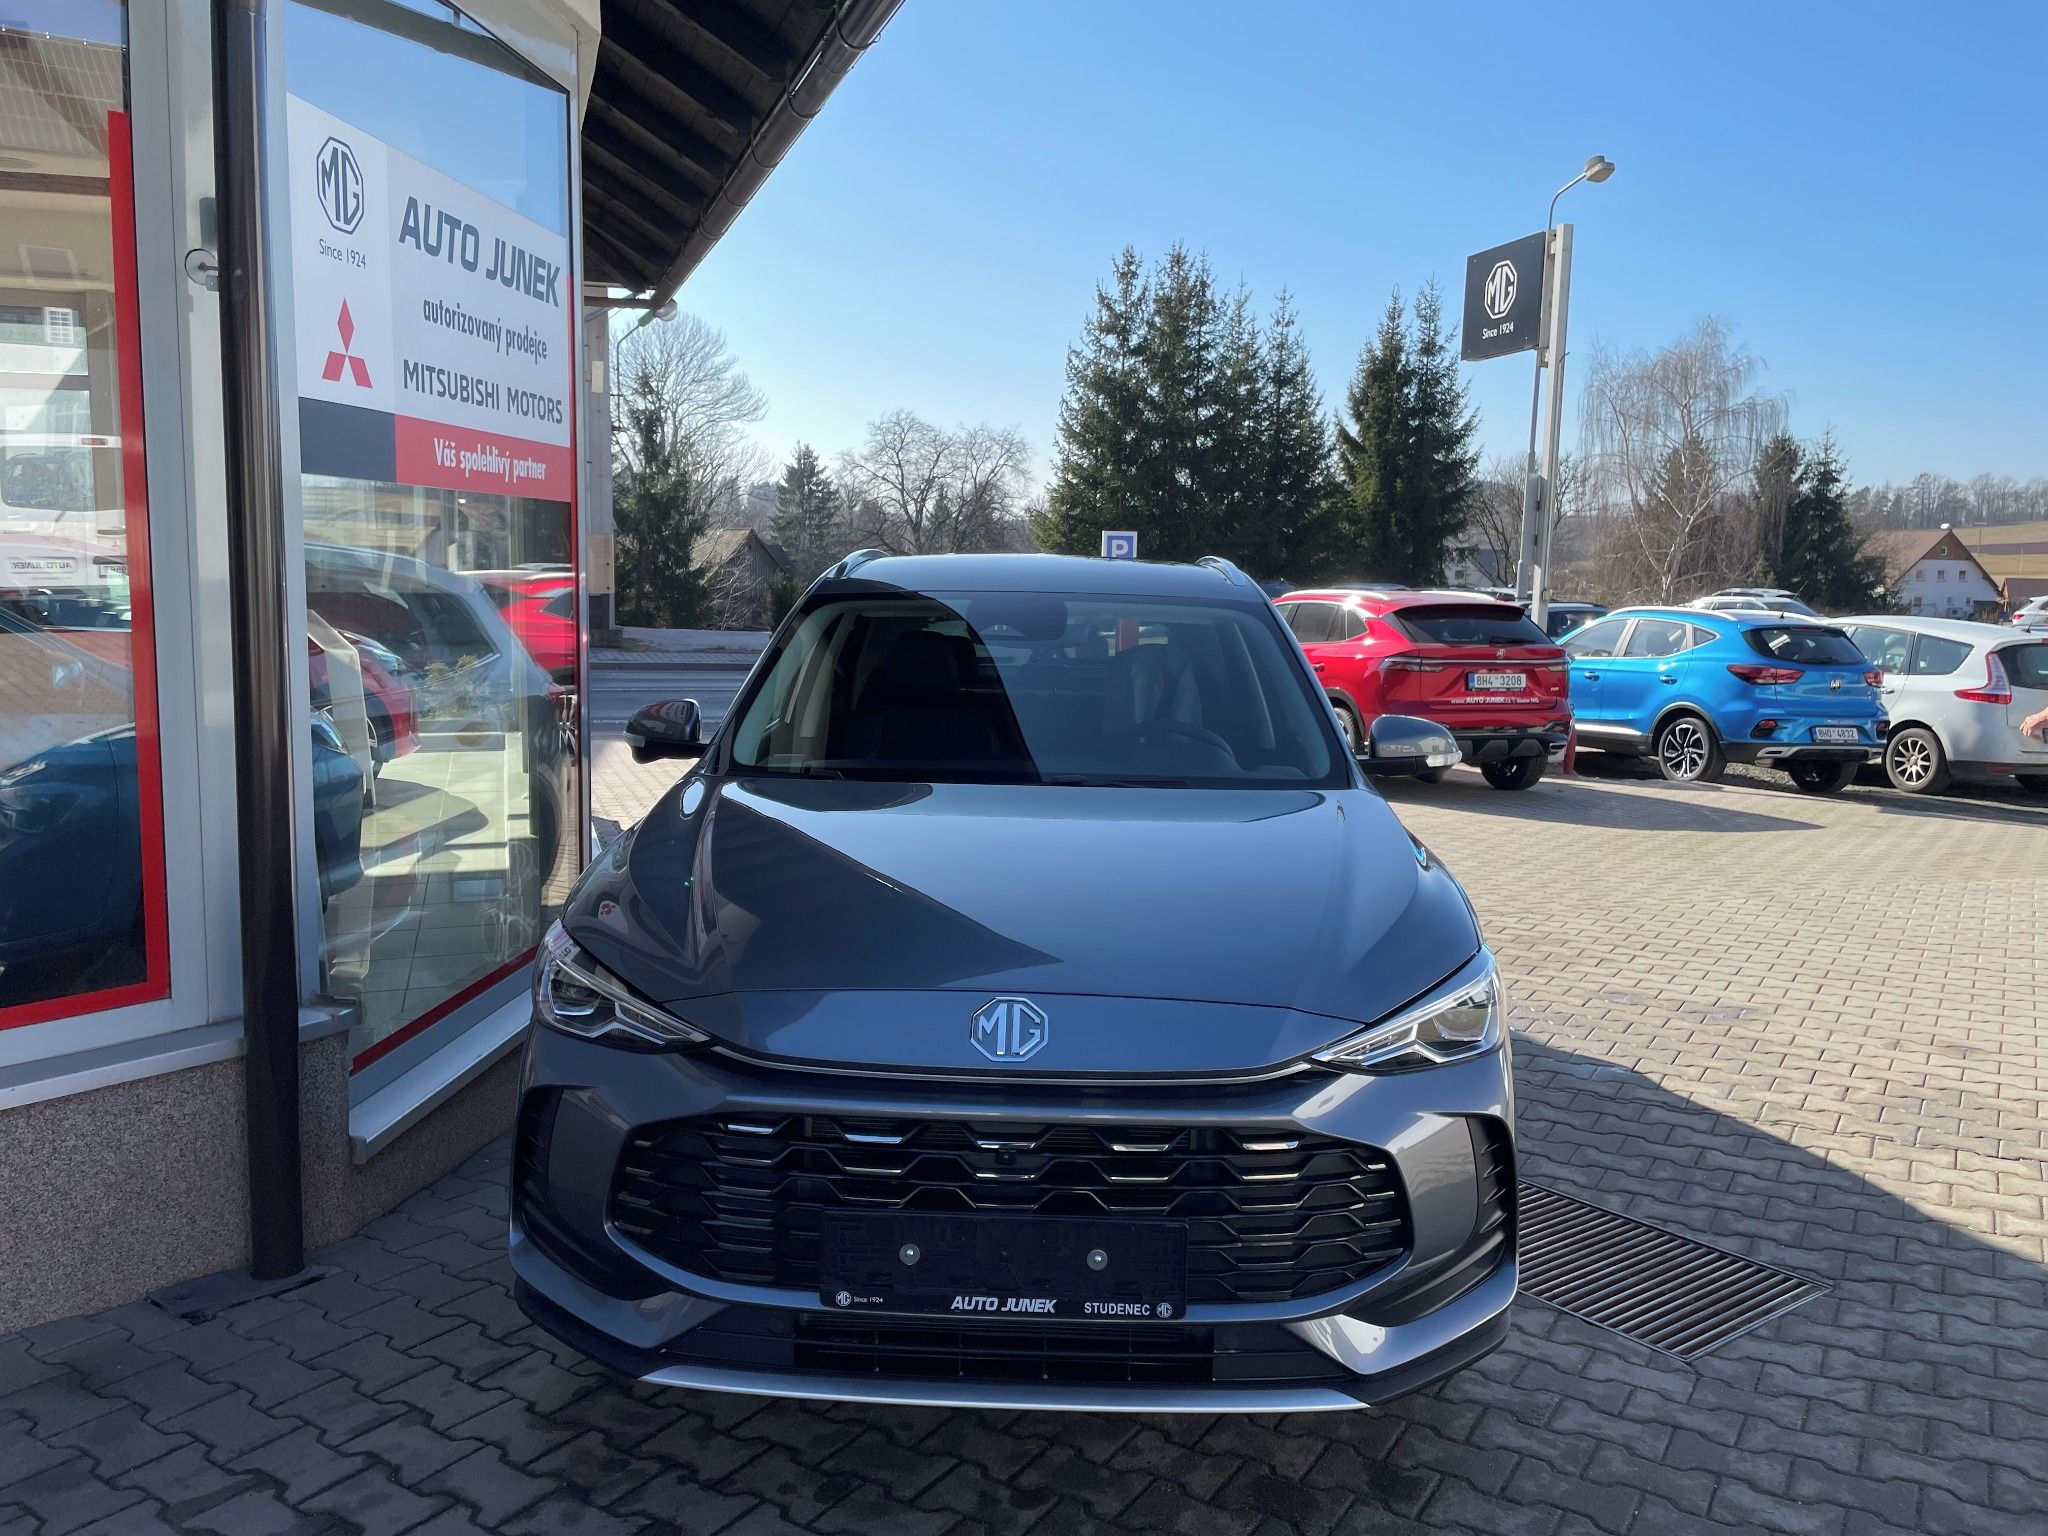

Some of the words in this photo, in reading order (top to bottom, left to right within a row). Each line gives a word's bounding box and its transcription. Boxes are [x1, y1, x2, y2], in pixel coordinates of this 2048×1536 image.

[319, 145, 362, 226] MG
[319, 238, 343, 262] Since
[345, 247, 367, 270] 1924
[399, 195, 480, 273] AUTO
[485, 237, 560, 308] JUNEK
[1487, 265, 1514, 314] MG
[423, 299, 502, 352] autorizovaný
[505, 325, 548, 364] prodejce
[1482, 328, 1498, 340] Since
[1499, 321, 1514, 335] 1924
[403, 359, 500, 411] MITSUBISHI
[507, 386, 563, 425] MOTORS
[434, 437, 456, 468] Váš
[459, 444, 510, 483] spolehlivý
[512, 458, 546, 483] partner
[1111, 539, 1129, 558] P
[1476, 675, 1493, 686] 8H4
[1500, 675, 1522, 686] 3208
[977, 1002, 1042, 1056] MG
[836, 1291, 851, 1306] MG
[950, 1296, 999, 1311] AUTO
[1000, 1297, 1057, 1313] JUNEK
[1084, 1302, 1150, 1316] STUDENEC
[1156, 1302, 1173, 1318] MG
